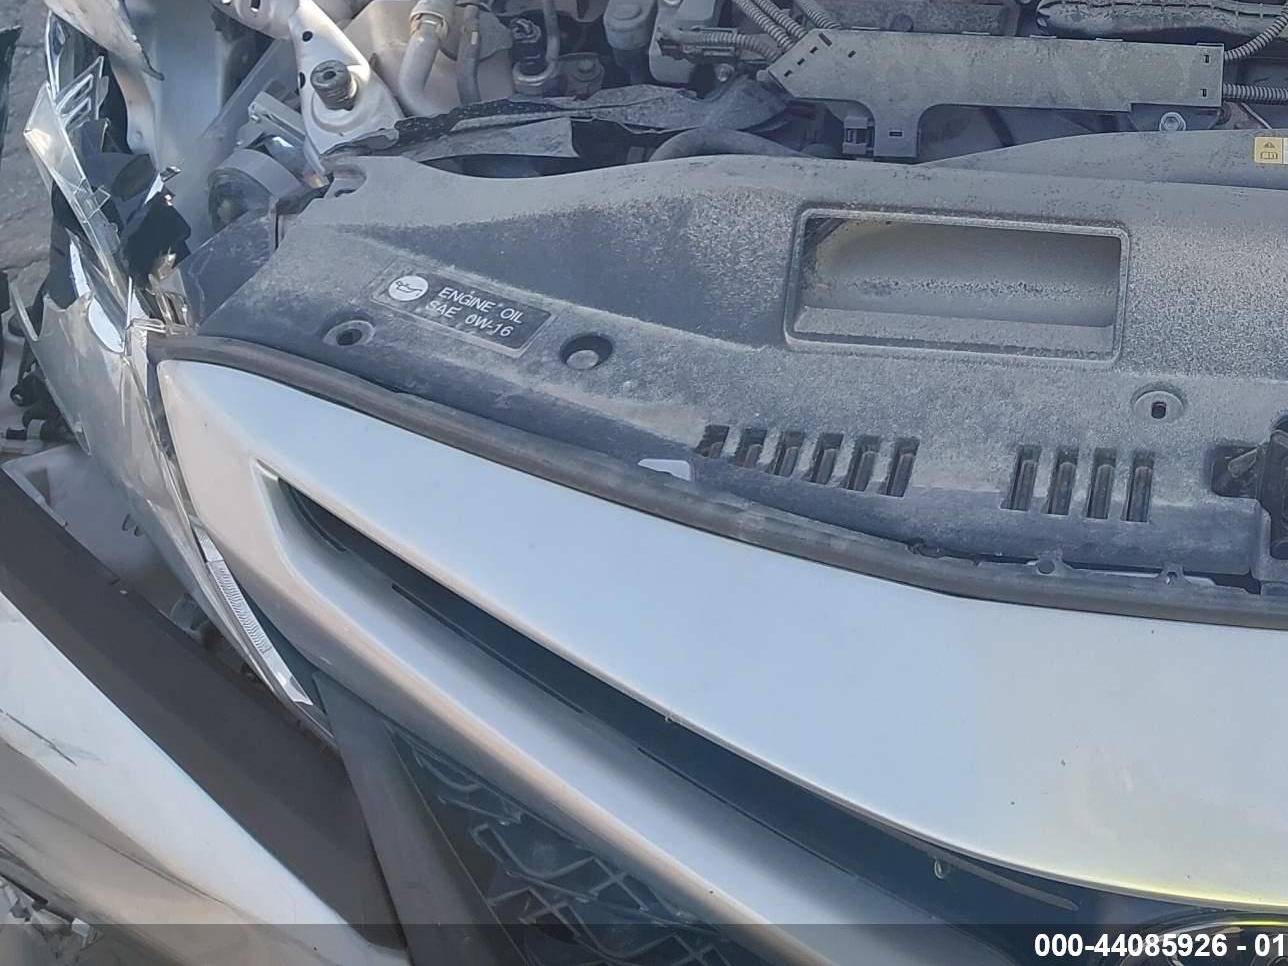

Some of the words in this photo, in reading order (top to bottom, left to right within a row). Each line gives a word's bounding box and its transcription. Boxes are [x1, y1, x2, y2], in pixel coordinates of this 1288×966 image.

[424, 299, 461, 319] SAE
[464, 312, 515, 338] 0W-16
[437, 286, 497, 314] ENGINE
[499, 305, 524, 325] OIL
